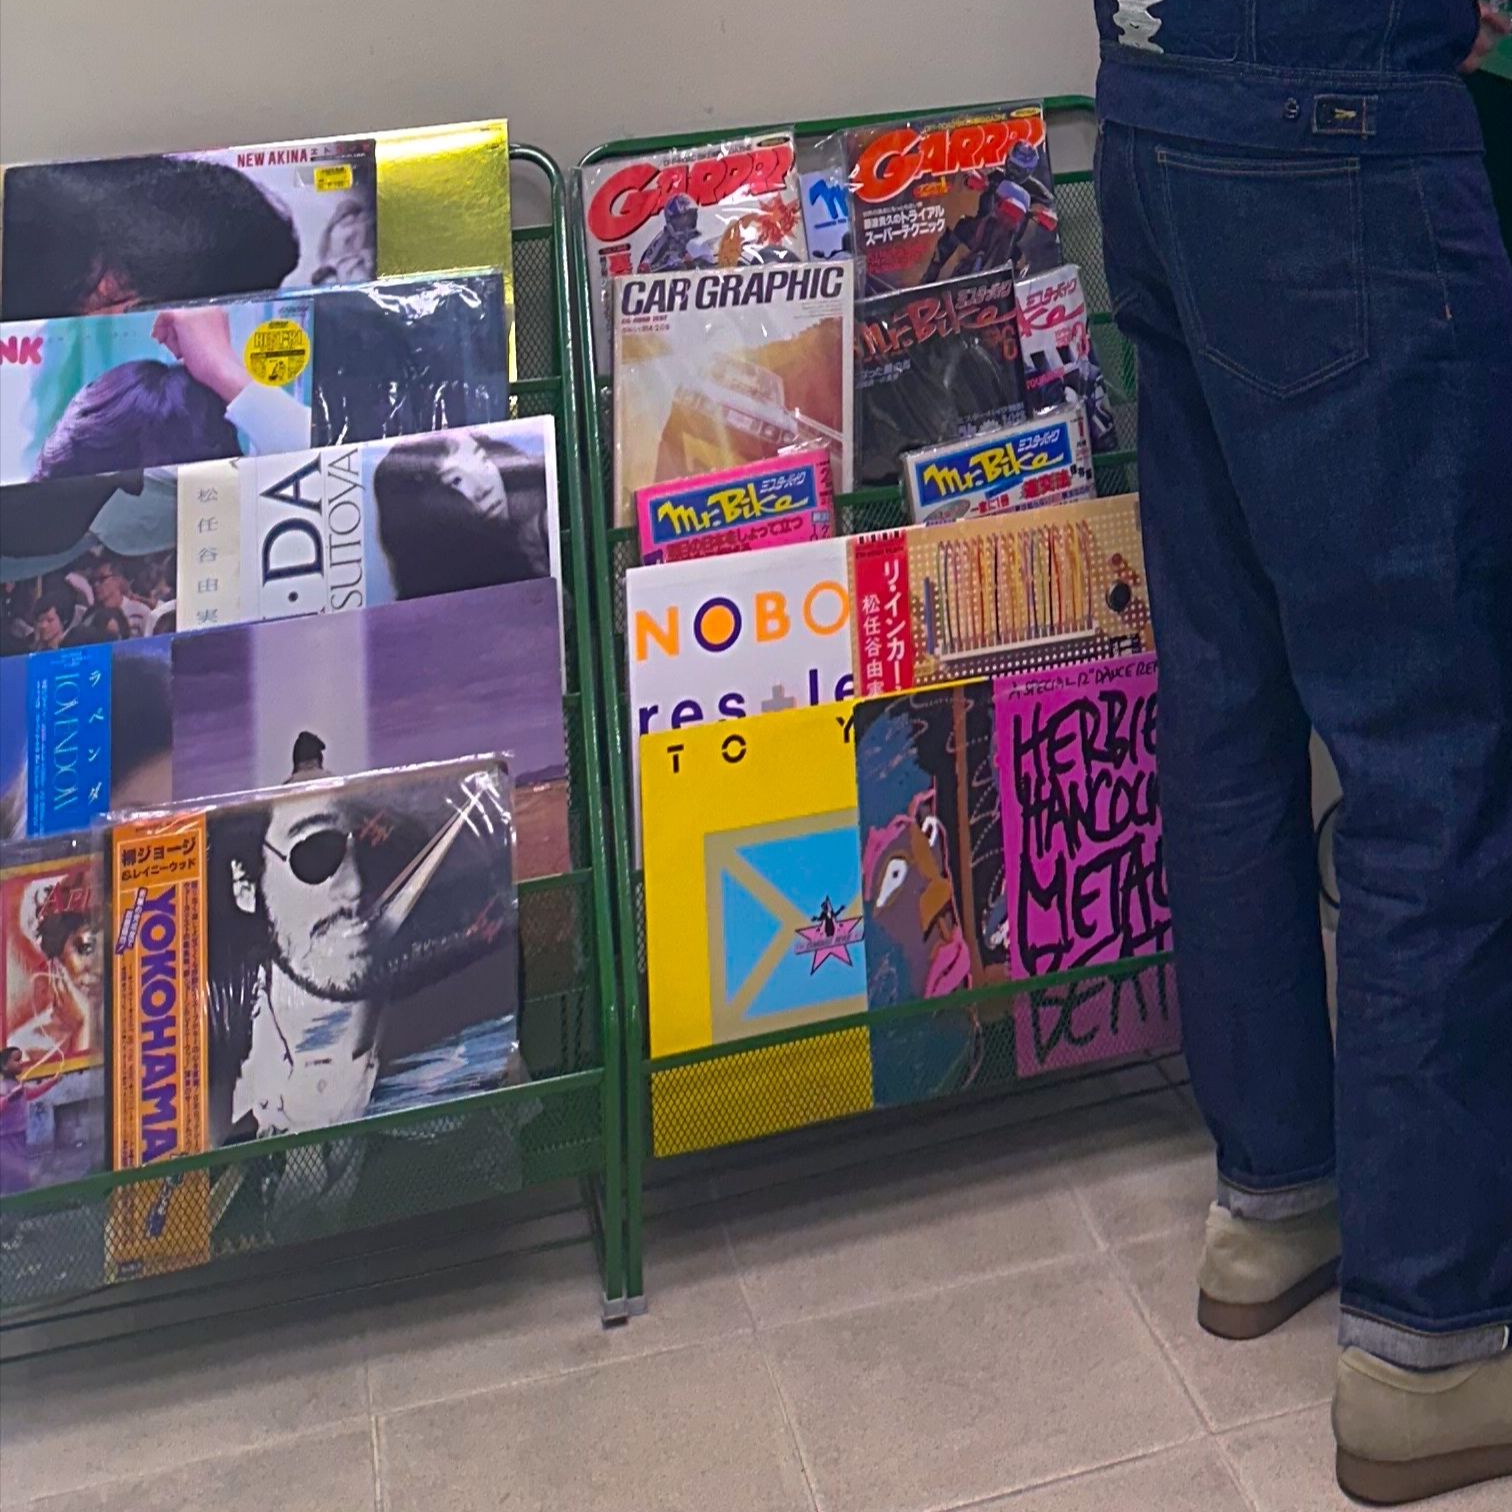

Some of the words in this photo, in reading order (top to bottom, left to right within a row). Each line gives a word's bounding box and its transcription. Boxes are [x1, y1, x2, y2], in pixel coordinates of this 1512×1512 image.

[237, 152, 264, 168] NEW
[268, 149, 307, 165] AKINA
[865, 218, 945, 246] スーパーテクニック
[622, 278, 690, 316] CAR
[695, 266, 844, 310] GRAPHIC
[923, 443, 1064, 496] Mr.Bike
[658, 483, 810, 535] Mr.Bike
[197, 488, 218, 624] 松任谷由実
[1095, 665, 1133, 685] DANCE
[143, 885, 177, 1165] YOKOHAMA
